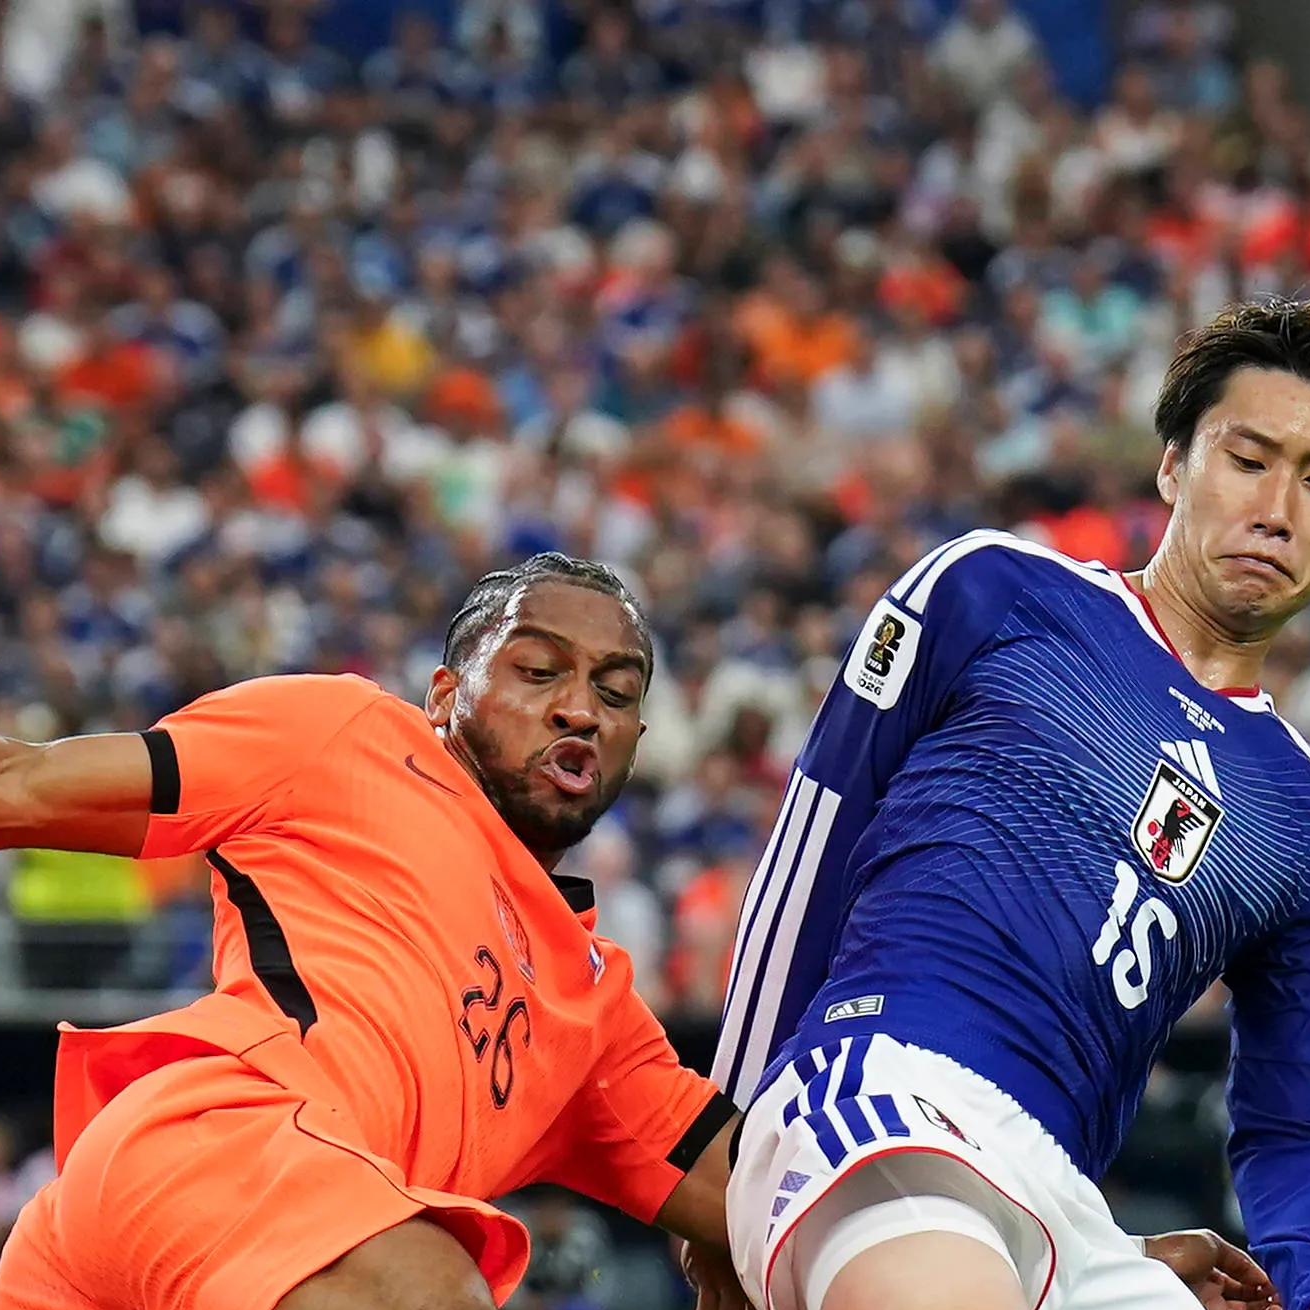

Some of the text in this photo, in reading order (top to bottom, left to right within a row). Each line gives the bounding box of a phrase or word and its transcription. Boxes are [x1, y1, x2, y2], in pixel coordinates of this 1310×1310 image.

[1172, 778, 1208, 809] JAPAN
[1091, 859, 1178, 1010] 15
[458, 945, 531, 1110] 26
